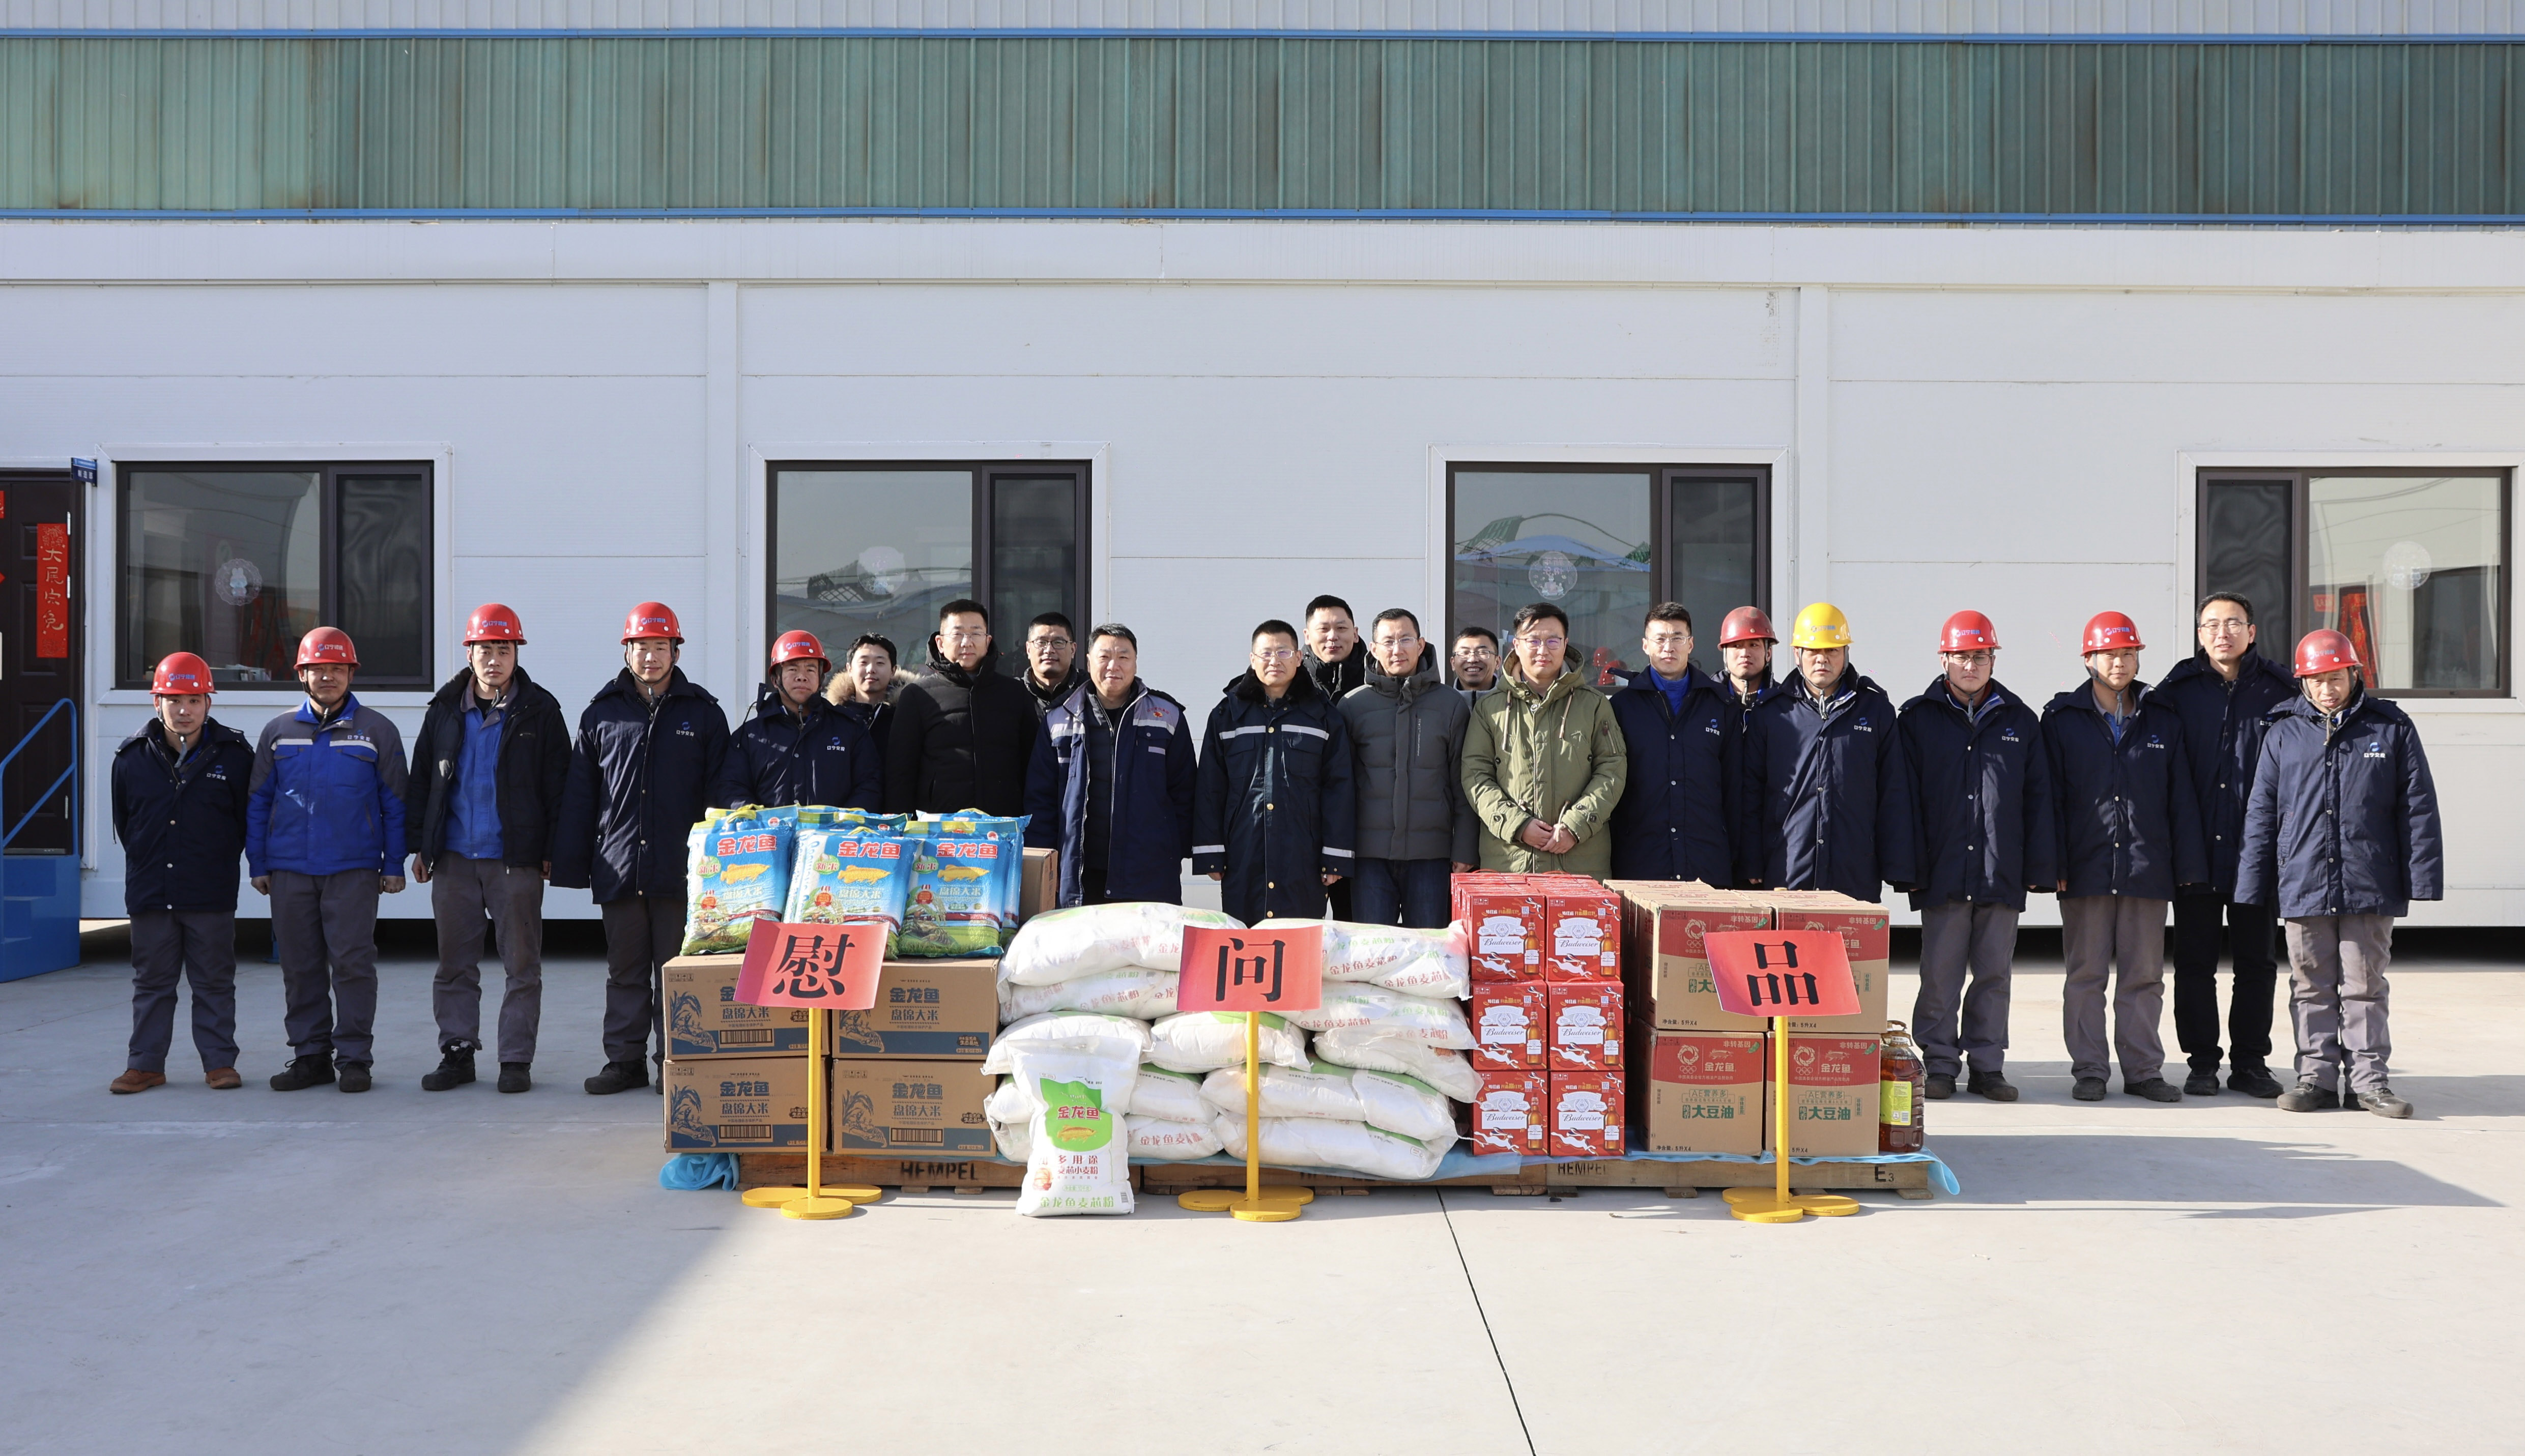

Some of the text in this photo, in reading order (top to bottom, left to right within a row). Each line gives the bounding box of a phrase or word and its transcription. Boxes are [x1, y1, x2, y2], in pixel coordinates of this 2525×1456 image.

[717, 834, 777, 856] 金龙鱼
[837, 840, 901, 859] 金龙鱼
[936, 842, 998, 859] 金龙鱼
[699, 864, 719, 874] 新米
[839, 890, 881, 899] 盘锦大米
[939, 887, 981, 896] 盘锦大米
[1731, 915, 1758, 923] 非转基因
[1483, 938, 1522, 946] Budweiser
[1559, 940, 1598, 948] Budweiser
[772, 934, 855, 998] 慰
[1216, 938, 1286, 1002] 问
[1329, 955, 1397, 975] 金龙鱼麦芯粉
[1746, 941, 1819, 1006] 品
[890, 987, 940, 1004] 金龙鱼
[723, 1007, 769, 1020] 盘锦大米
[892, 1009, 938, 1021] 盘锦大米
[1301, 1017, 1370, 1028] 金龙鱼麦芯粉
[1484, 1028, 1524, 1036] Budweiser
[1562, 1028, 1601, 1036] Budweiser
[1705, 1062, 1734, 1072] 金龙鱼
[1821, 1064, 1851, 1073] 金龙鱼
[720, 1081, 770, 1097] 金龙鱼
[892, 1083, 943, 1100] 金龙鱼
[1692, 1089, 1727, 1097] AE营养多
[722, 1102, 769, 1115] 盘锦大米
[894, 1104, 941, 1117] 盘锦大米
[1057, 1105, 1100, 1120] 金龙鱼
[1692, 1104, 1734, 1119] 大豆油
[1809, 1106, 1851, 1120] 大豆油
[1485, 1113, 1525, 1121] Budweiser
[1562, 1114, 1602, 1122] Budweiser
[1058, 1155, 1098, 1164] 多用途
[1058, 1166, 1098, 1175] 麦芯小麦粉
[1875, 1166, 1895, 1182] E 3
[1040, 1196, 1114, 1208] 金龙鱼麦芯粉
